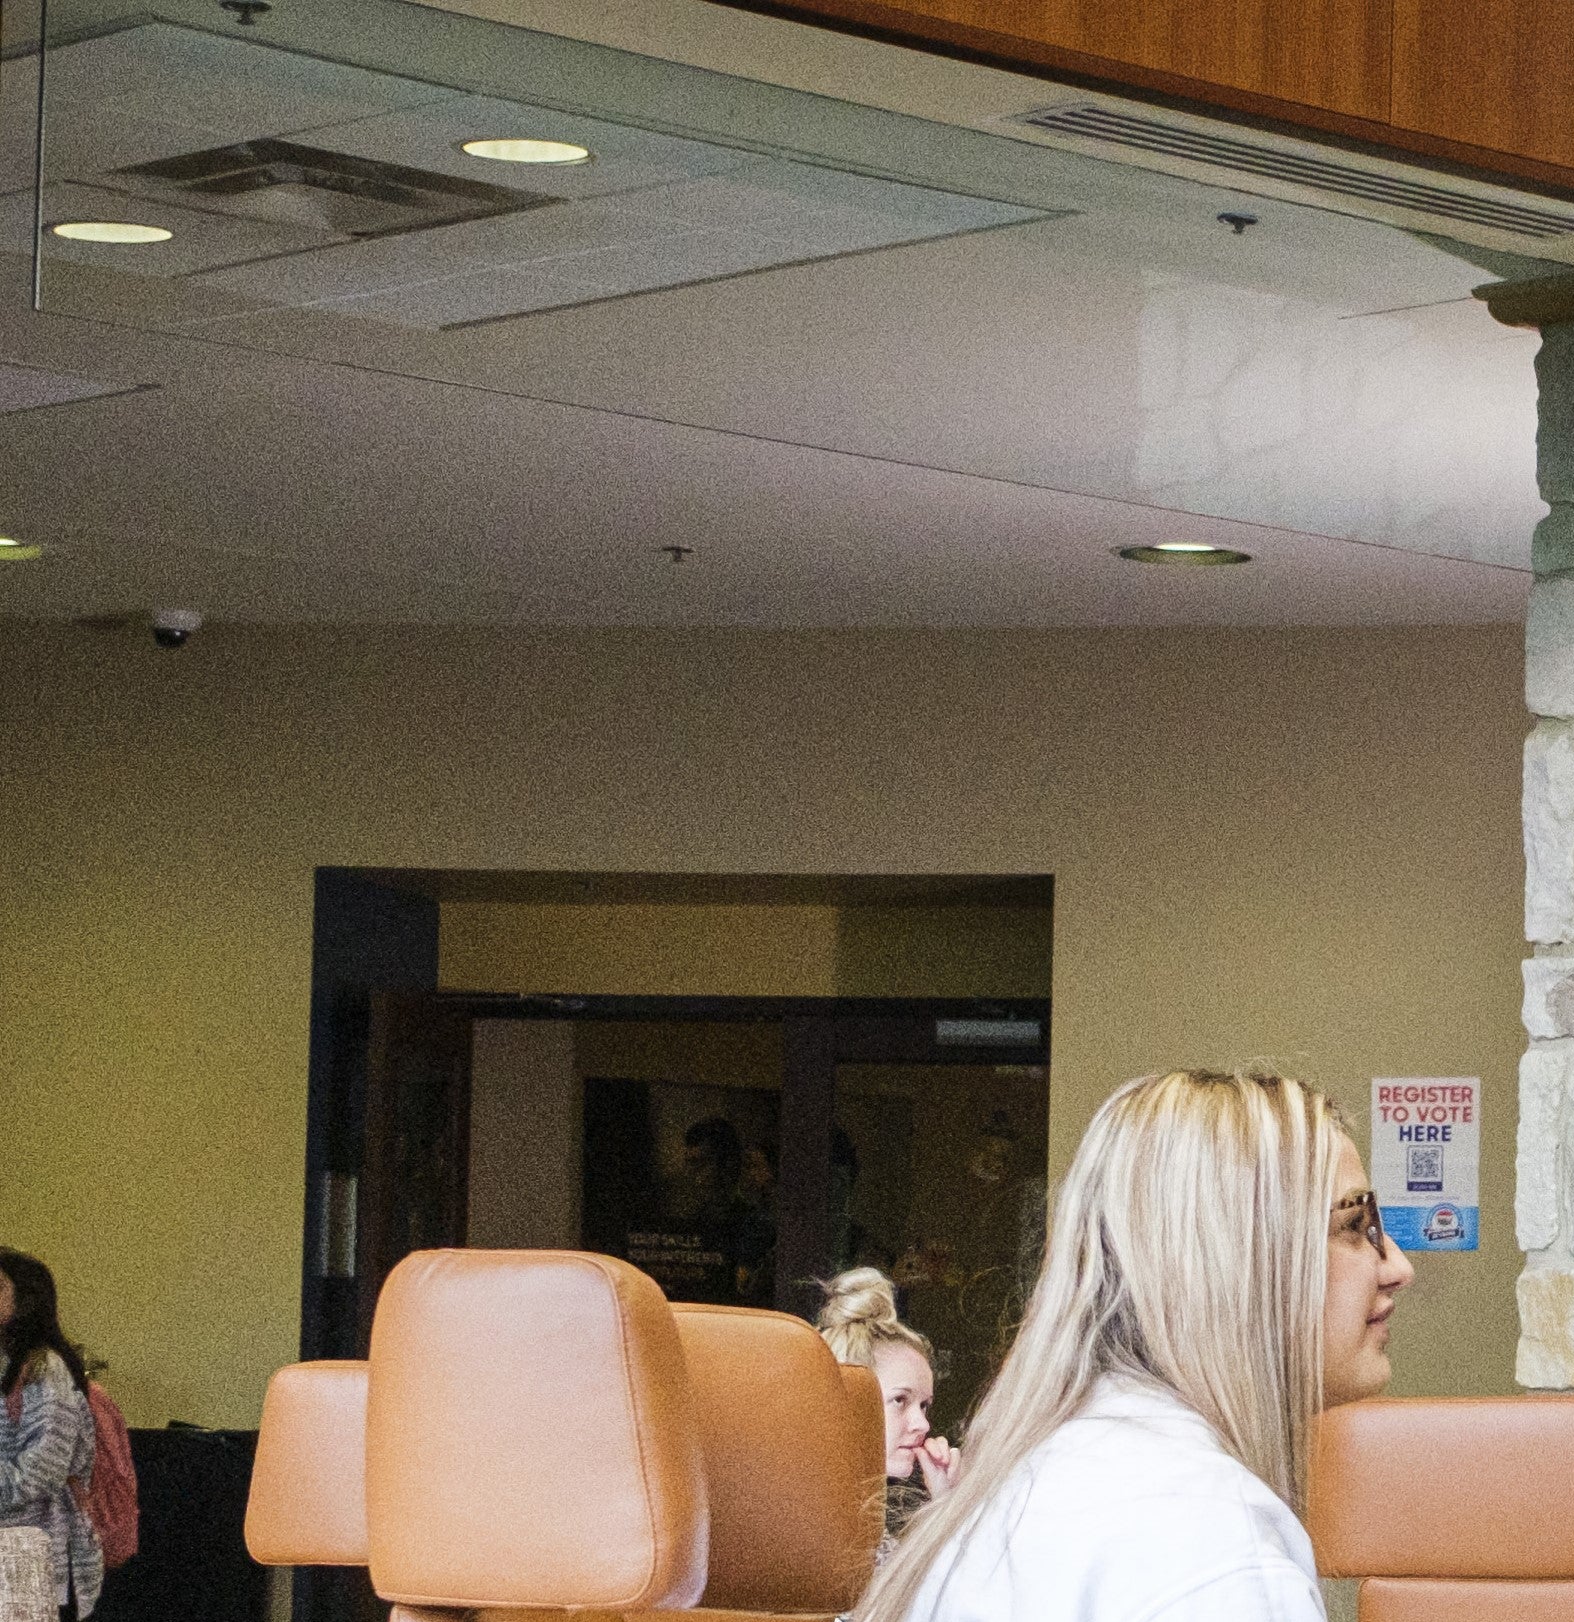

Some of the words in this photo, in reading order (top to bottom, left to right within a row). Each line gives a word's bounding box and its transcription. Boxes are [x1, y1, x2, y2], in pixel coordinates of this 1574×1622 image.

[1378, 1086, 1474, 1103] REGISTER
[1380, 1106, 1409, 1122] TO
[1417, 1106, 1473, 1123] VOTE
[1399, 1126, 1452, 1142] HERE
